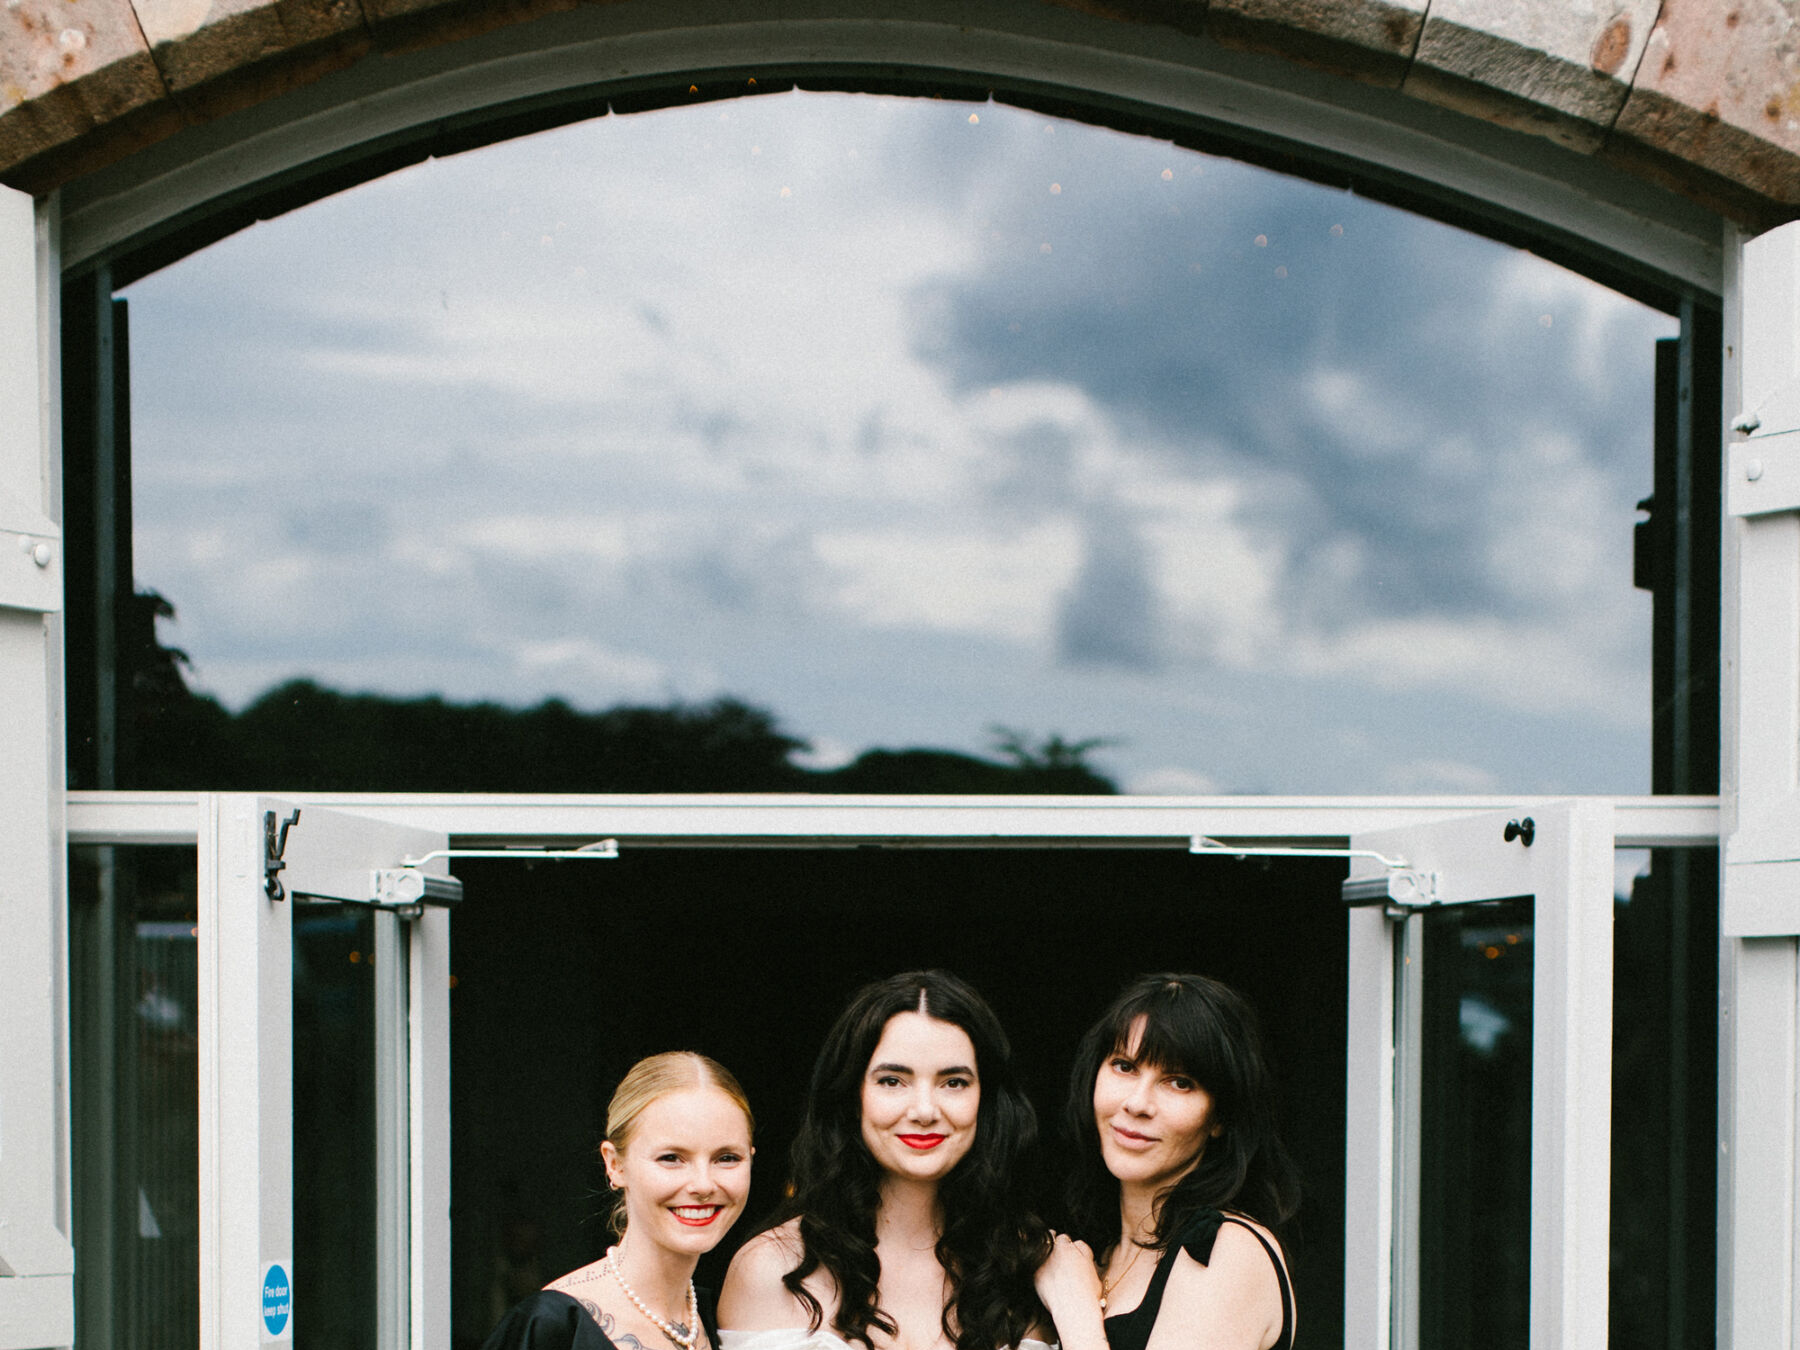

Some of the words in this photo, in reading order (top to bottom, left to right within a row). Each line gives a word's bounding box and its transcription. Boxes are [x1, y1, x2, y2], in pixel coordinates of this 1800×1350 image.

[265, 1286, 274, 1298] Fire
[275, 1285, 288, 1297] door
[264, 1305, 276, 1319] keep
[277, 1303, 289, 1315] shut
